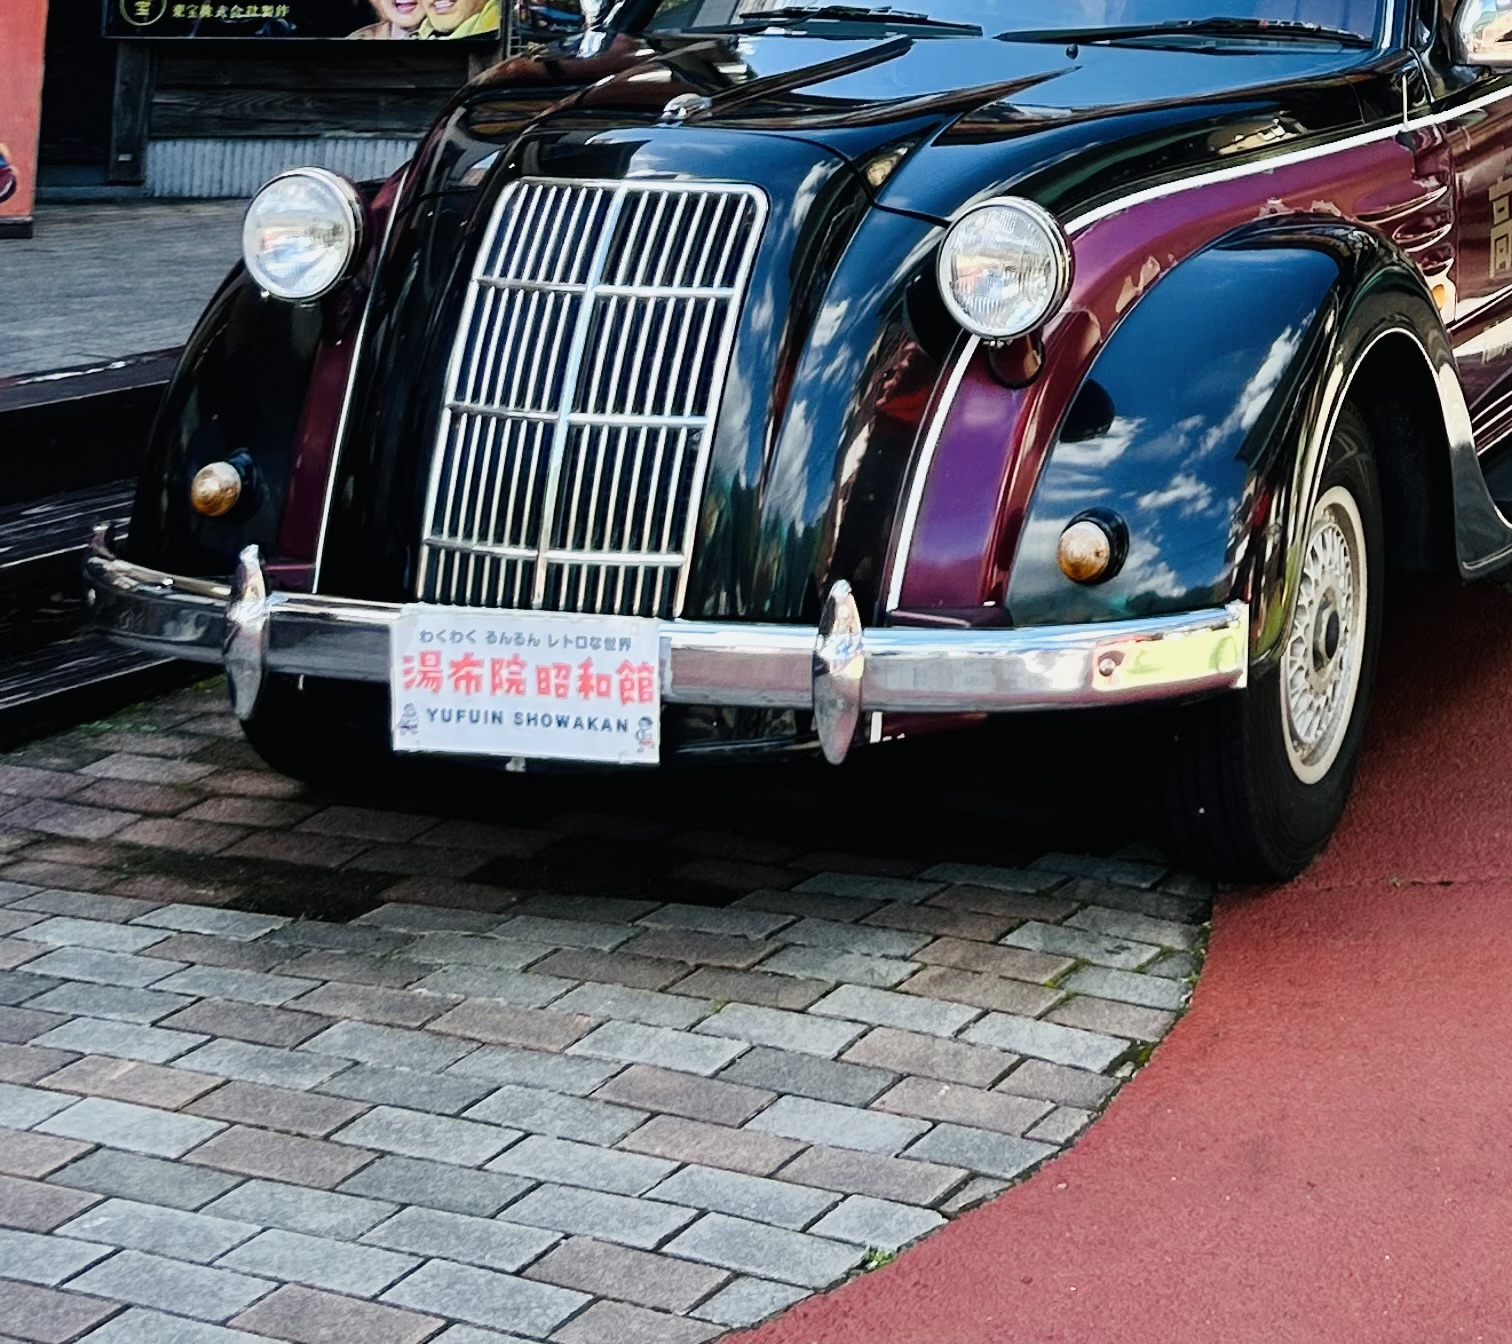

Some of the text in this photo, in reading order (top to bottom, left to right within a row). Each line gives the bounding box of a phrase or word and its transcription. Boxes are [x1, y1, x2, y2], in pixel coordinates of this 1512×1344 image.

[419, 628, 632, 652] わくわく るんるん レトロな世界
[402, 649, 656, 706] 湯布院昭和館
[426, 708, 630, 734] YUFUIN SHOWAKAN
